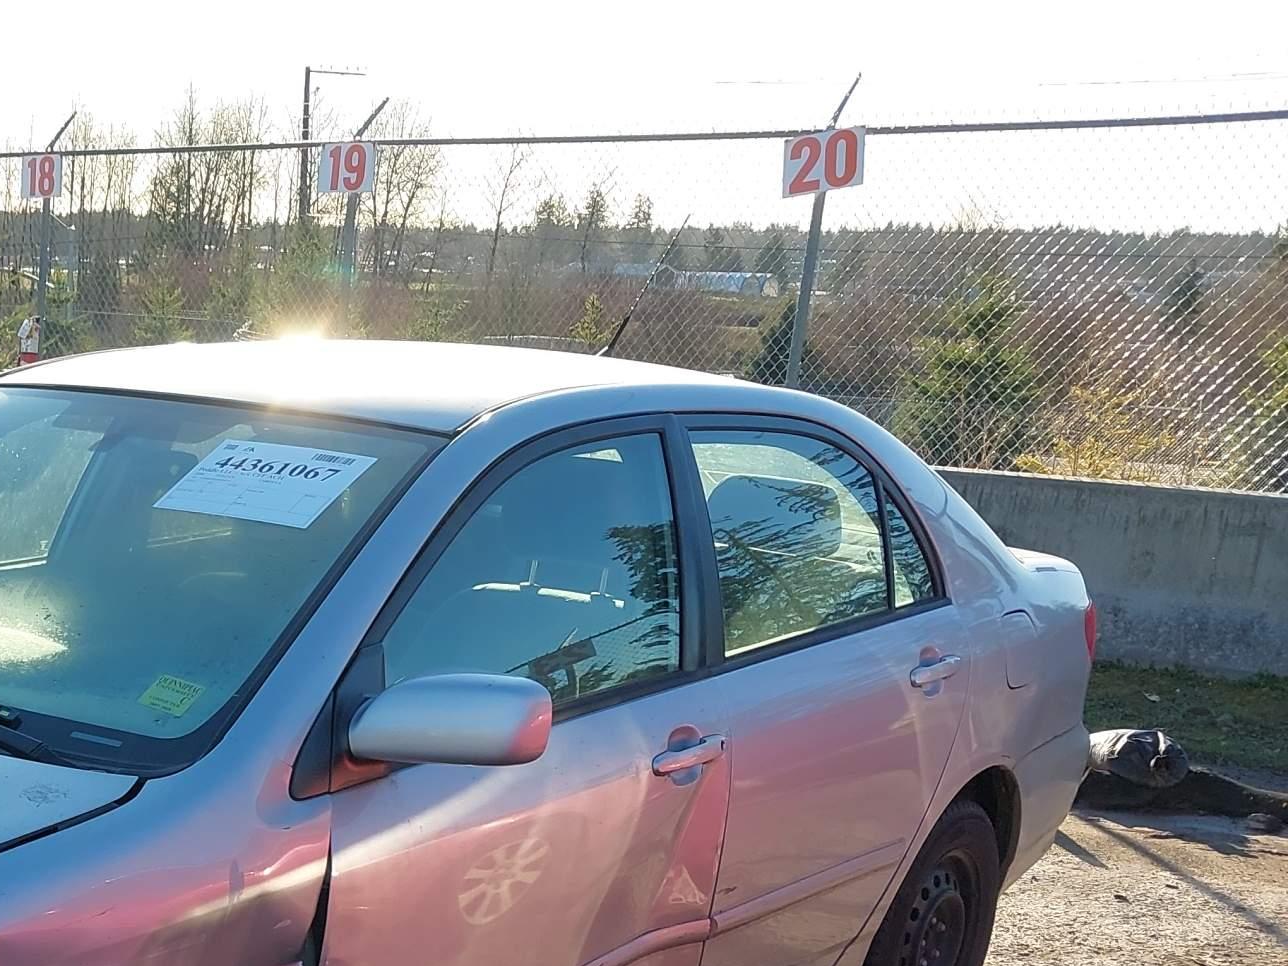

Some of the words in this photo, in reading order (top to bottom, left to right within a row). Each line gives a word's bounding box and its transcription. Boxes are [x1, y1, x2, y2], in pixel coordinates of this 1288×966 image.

[26, 154, 55, 197] 18
[329, 144, 366, 191] 19
[789, 129, 858, 194] 20
[215, 456, 342, 482] 44361067
